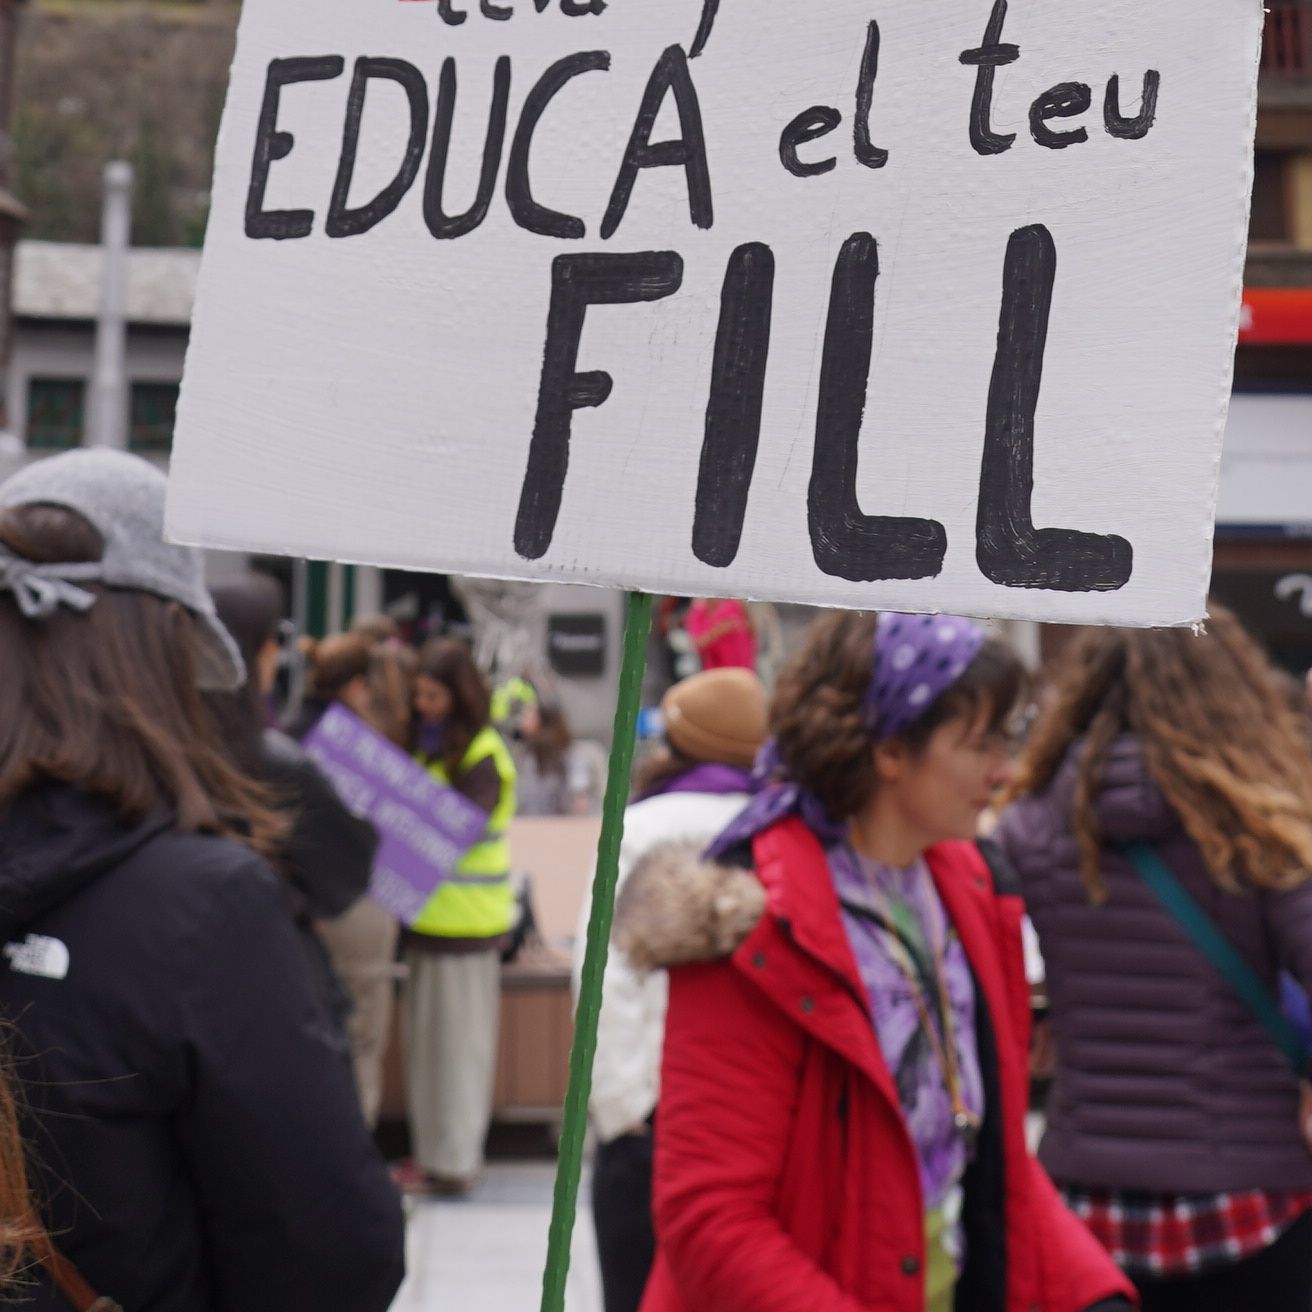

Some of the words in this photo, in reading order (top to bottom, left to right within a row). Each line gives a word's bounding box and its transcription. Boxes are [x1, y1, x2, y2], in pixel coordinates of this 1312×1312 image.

[244, 44, 714, 241] EDUCA
[778, 19, 888, 178] el
[513, 222, 1134, 593] FILL
